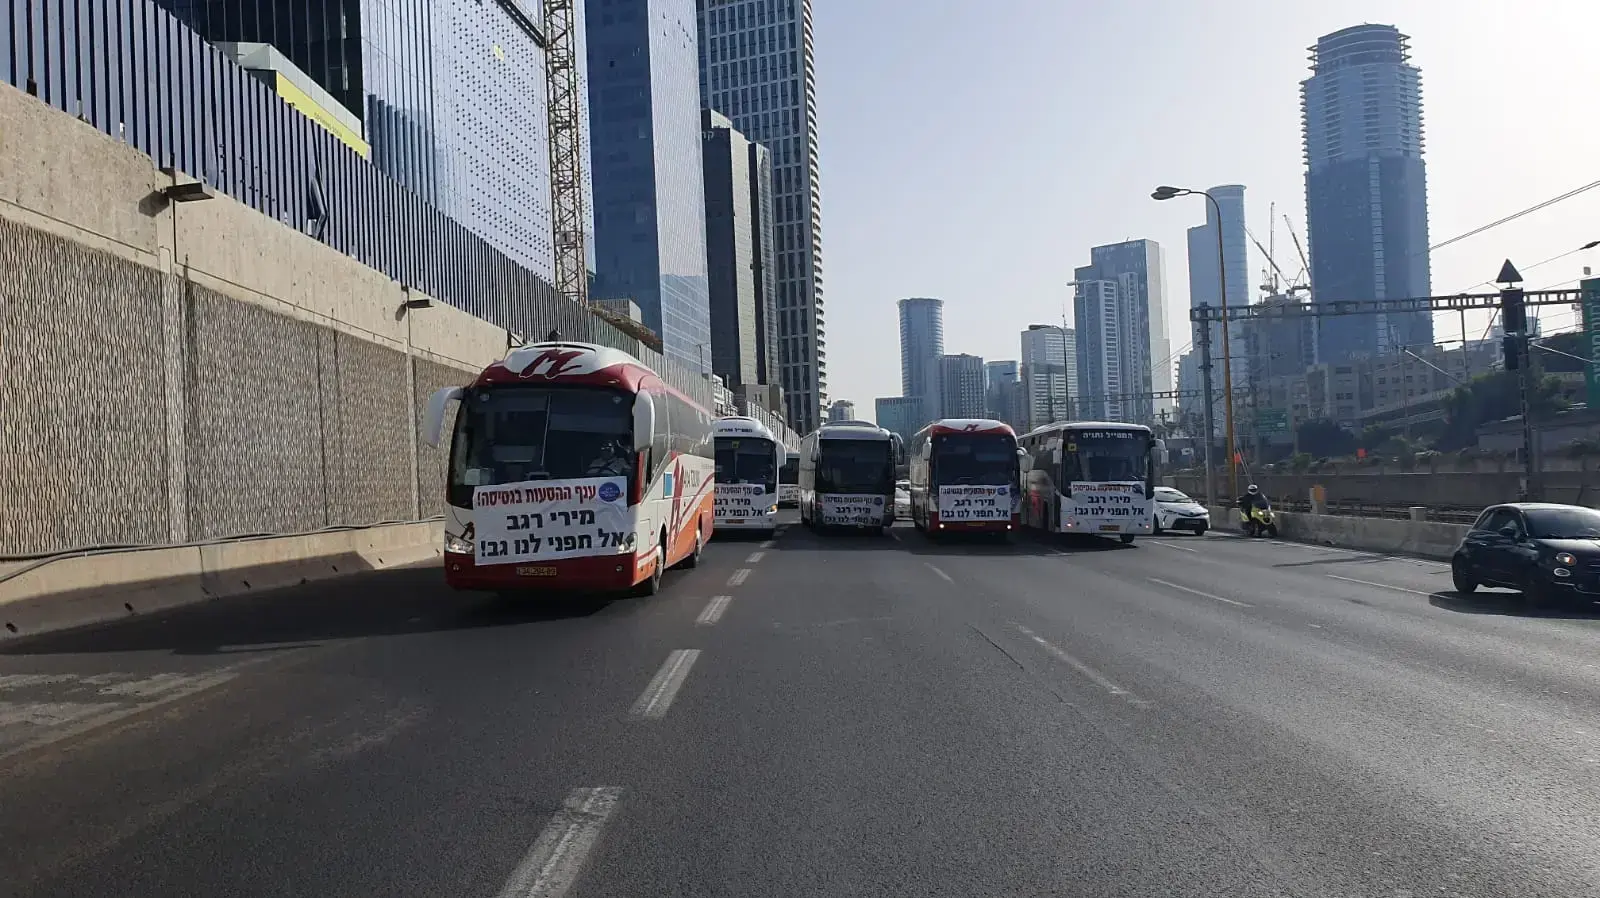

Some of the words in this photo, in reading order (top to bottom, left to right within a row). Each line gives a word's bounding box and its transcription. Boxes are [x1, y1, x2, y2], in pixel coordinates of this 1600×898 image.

[525, 486, 571, 504] ההסעות
[575, 485, 596, 504] ענף
[550, 510, 595, 526] מירי
[752, 507, 763, 516] אל
[957, 508, 970, 518] לנו
[996, 508, 1008, 517] אל
[1091, 506, 1104, 515] לנו
[1132, 506, 1144, 515] אל
[506, 513, 543, 530] רגב
[514, 534, 542, 554] לנו
[548, 534, 592, 552] תפני
[598, 528, 624, 548] אל
[480, 540, 508, 557] גב!
